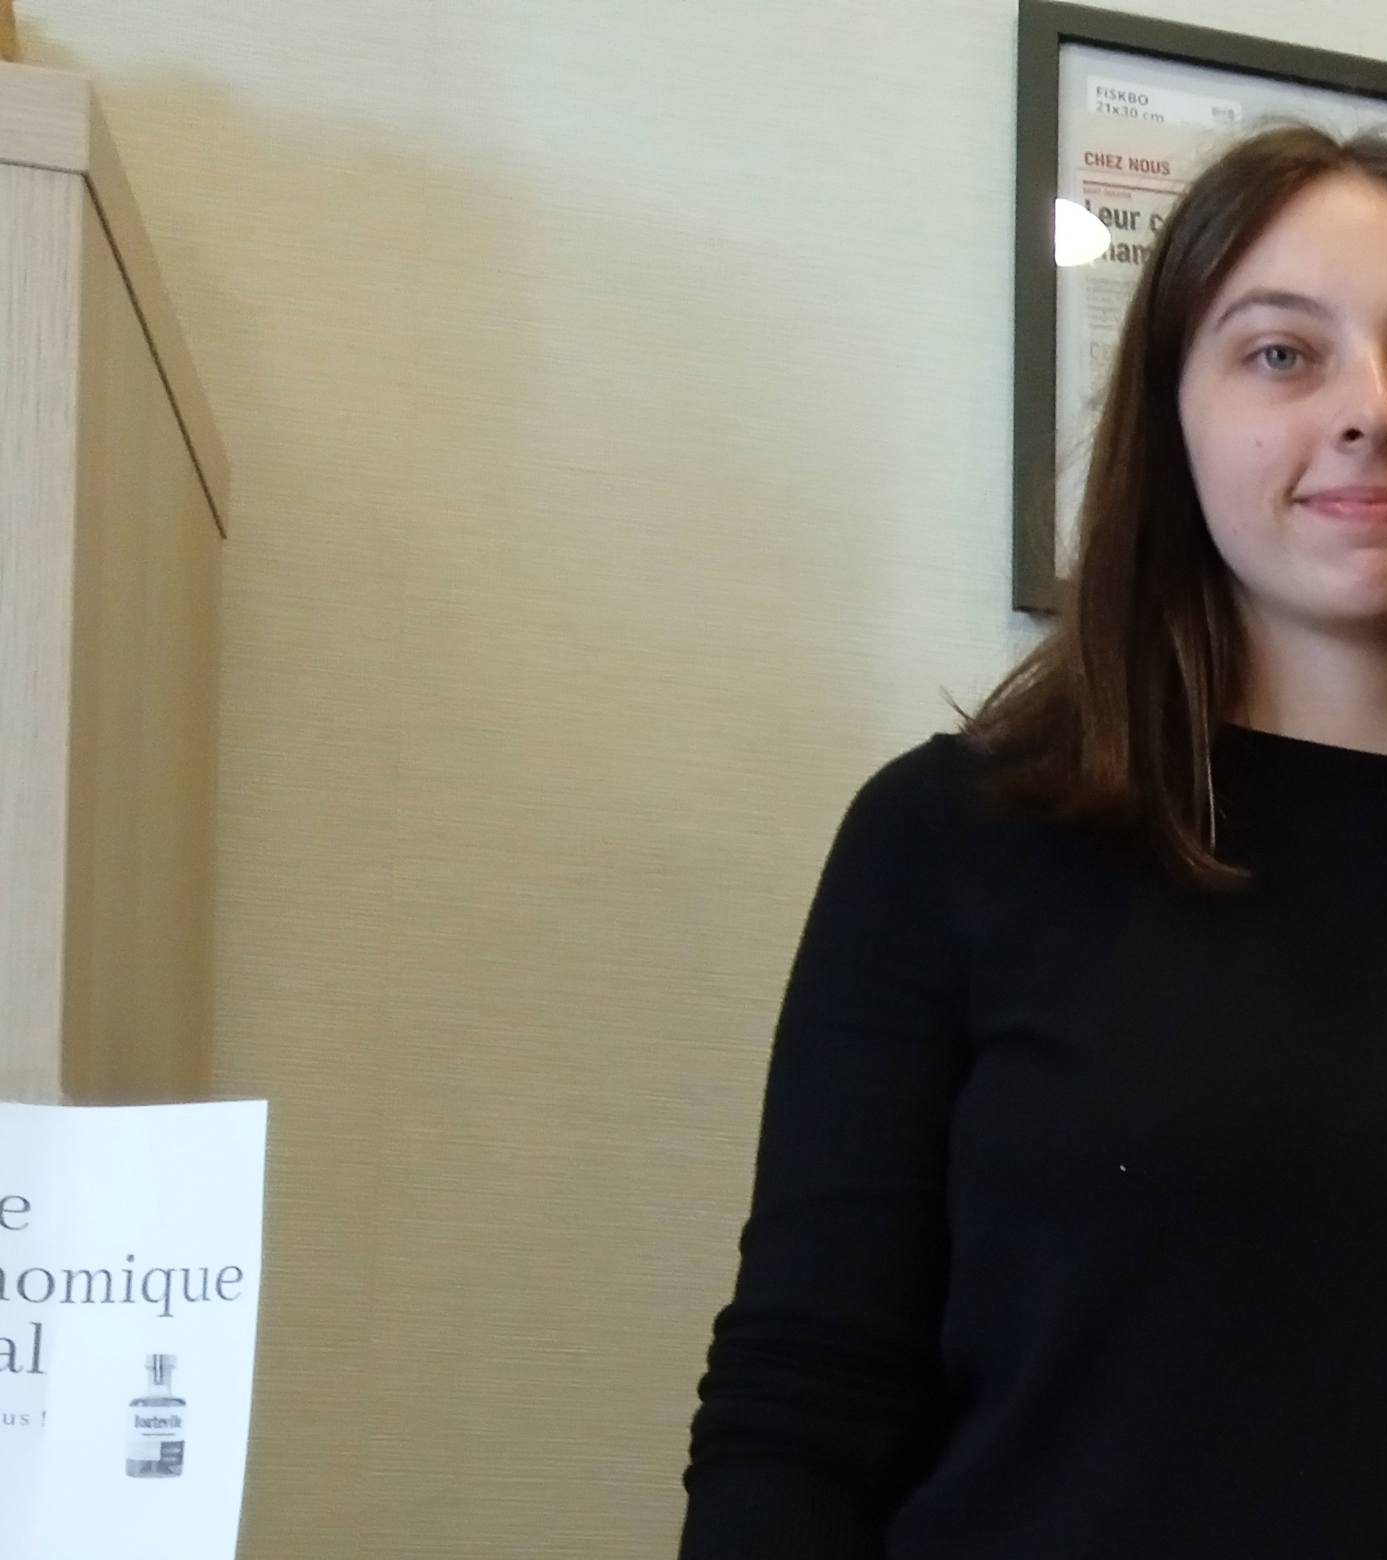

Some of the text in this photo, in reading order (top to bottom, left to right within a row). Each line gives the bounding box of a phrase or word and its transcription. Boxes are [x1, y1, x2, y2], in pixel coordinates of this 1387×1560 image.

[1096, 85, 1149, 106] FISKBO
[1096, 101, 1138, 119] 21x30
[1084, 151, 1171, 175] CHEZ NOUS
